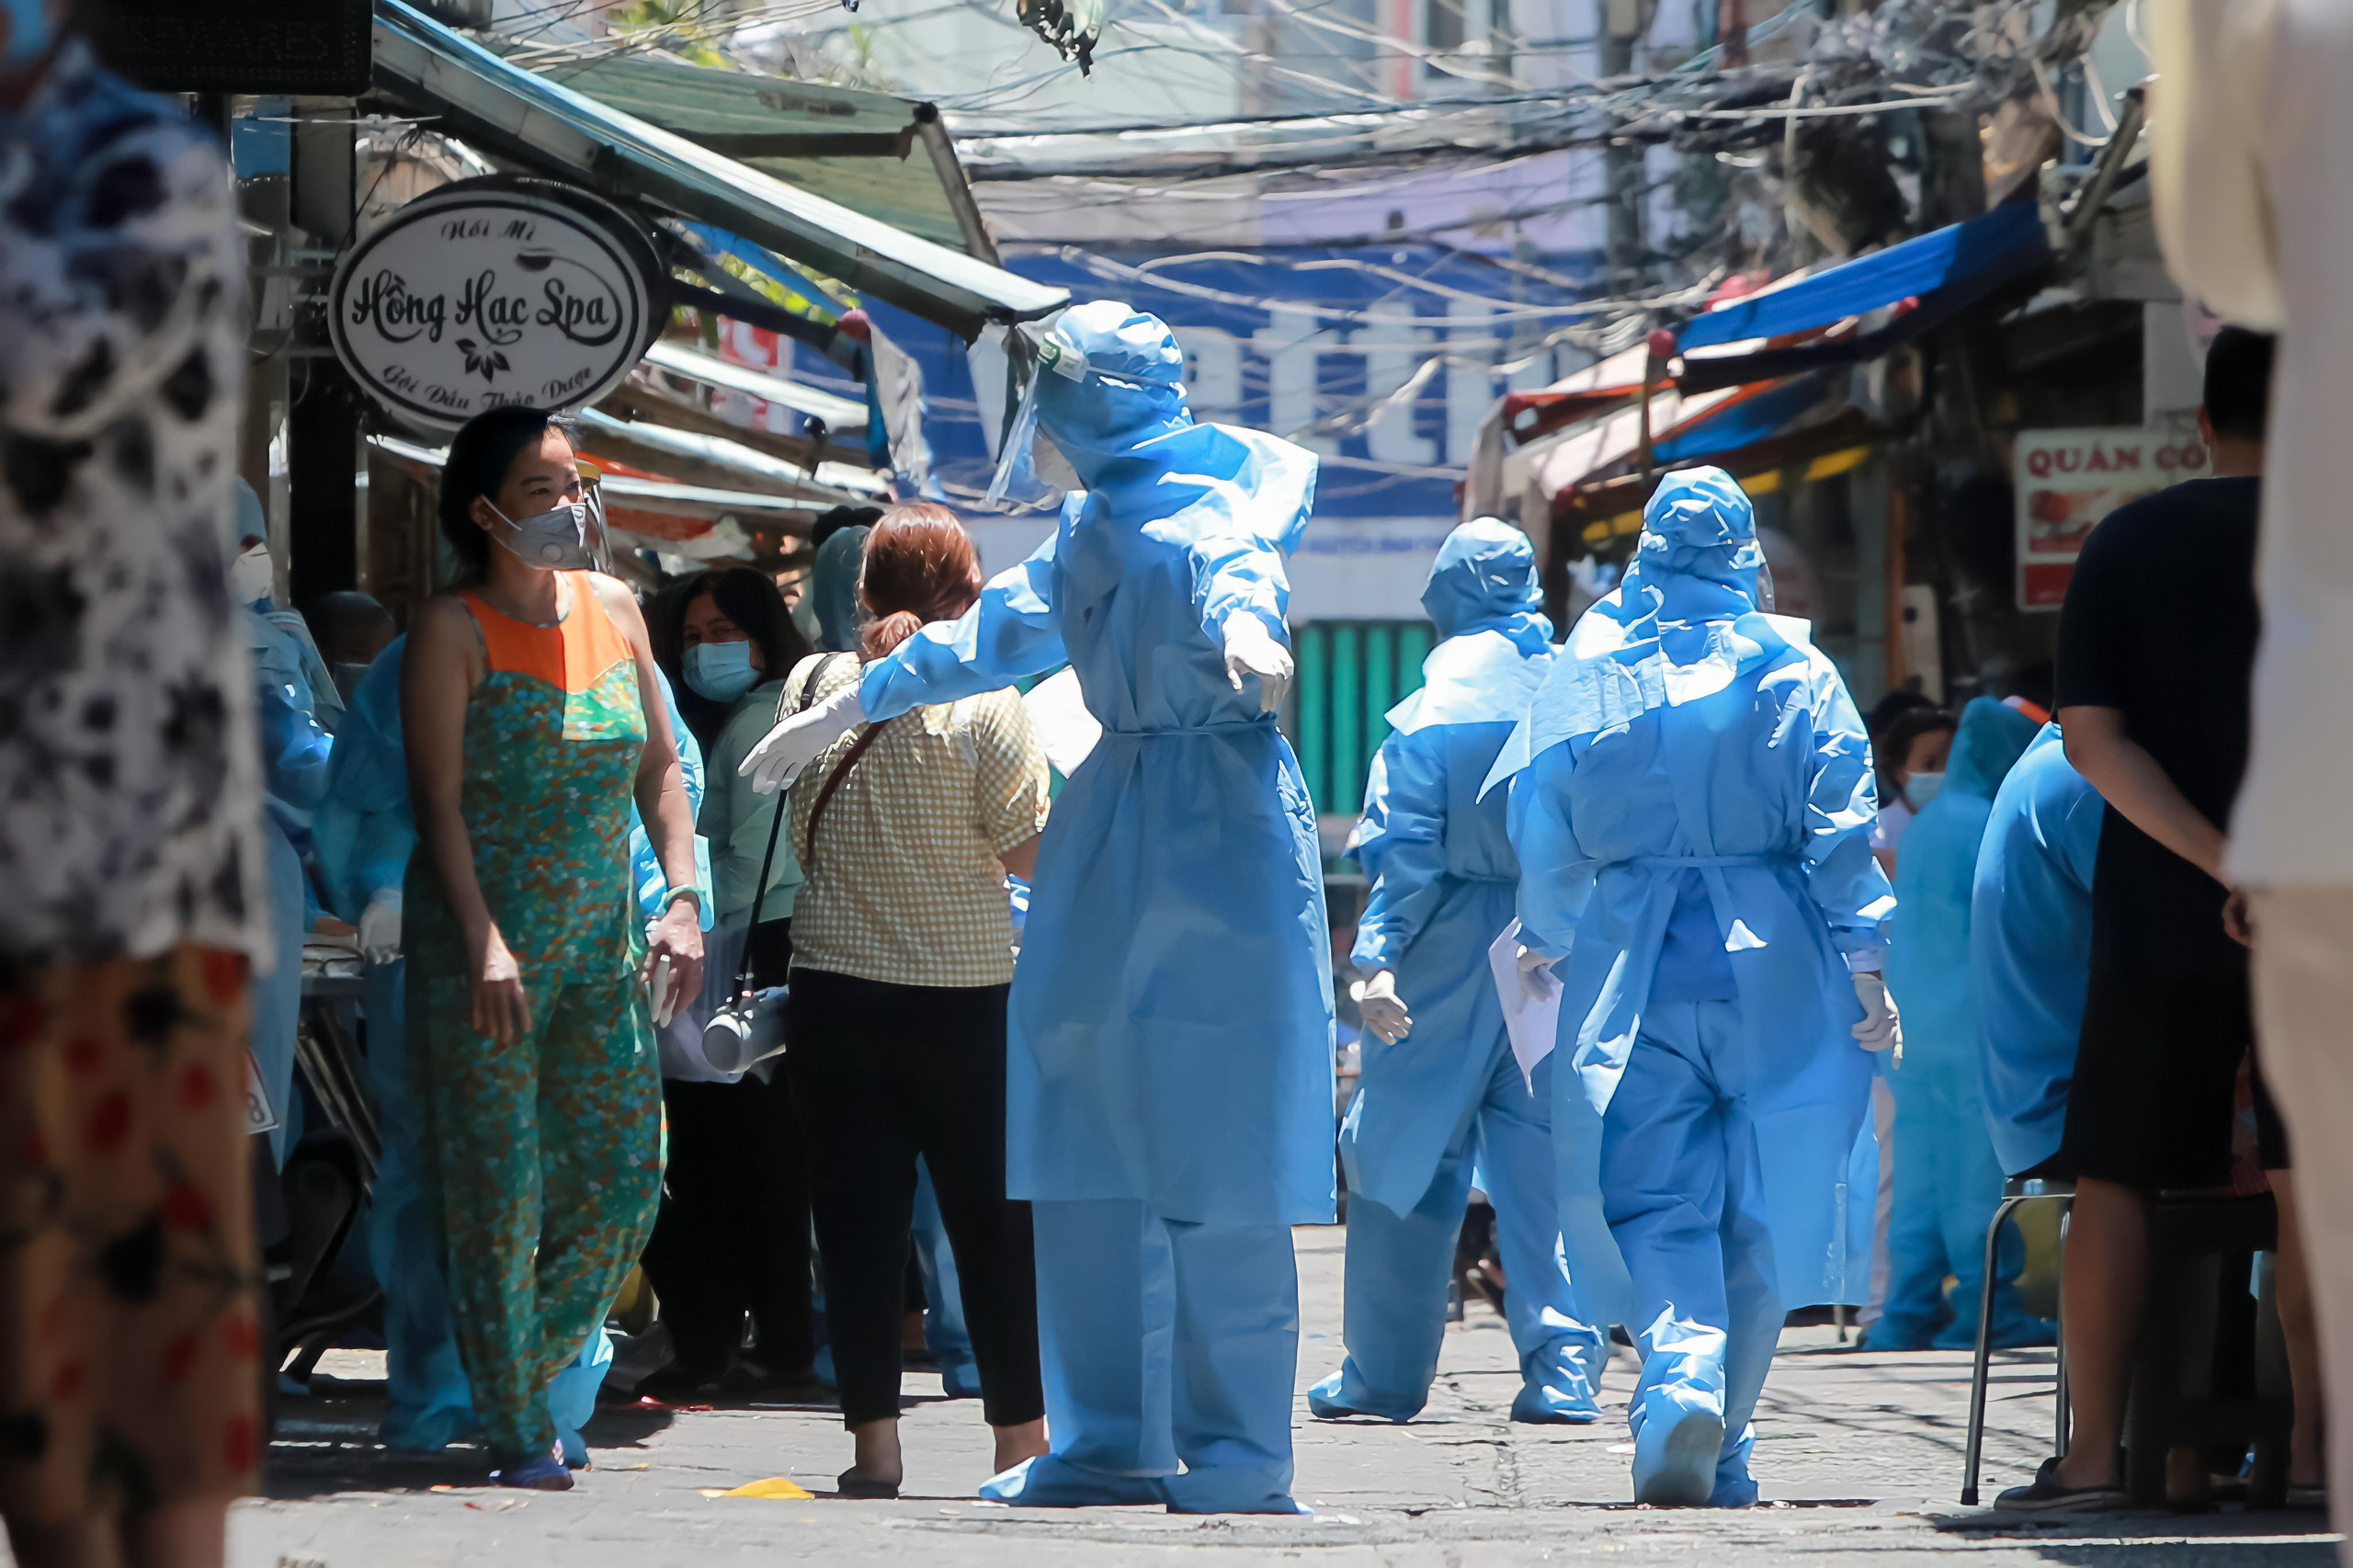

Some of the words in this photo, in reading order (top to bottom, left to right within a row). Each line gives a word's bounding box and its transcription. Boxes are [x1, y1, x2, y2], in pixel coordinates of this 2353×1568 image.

[351, 268, 448, 344] Hồng
[455, 268, 530, 347] Hạc
[536, 278, 620, 347] Spa
